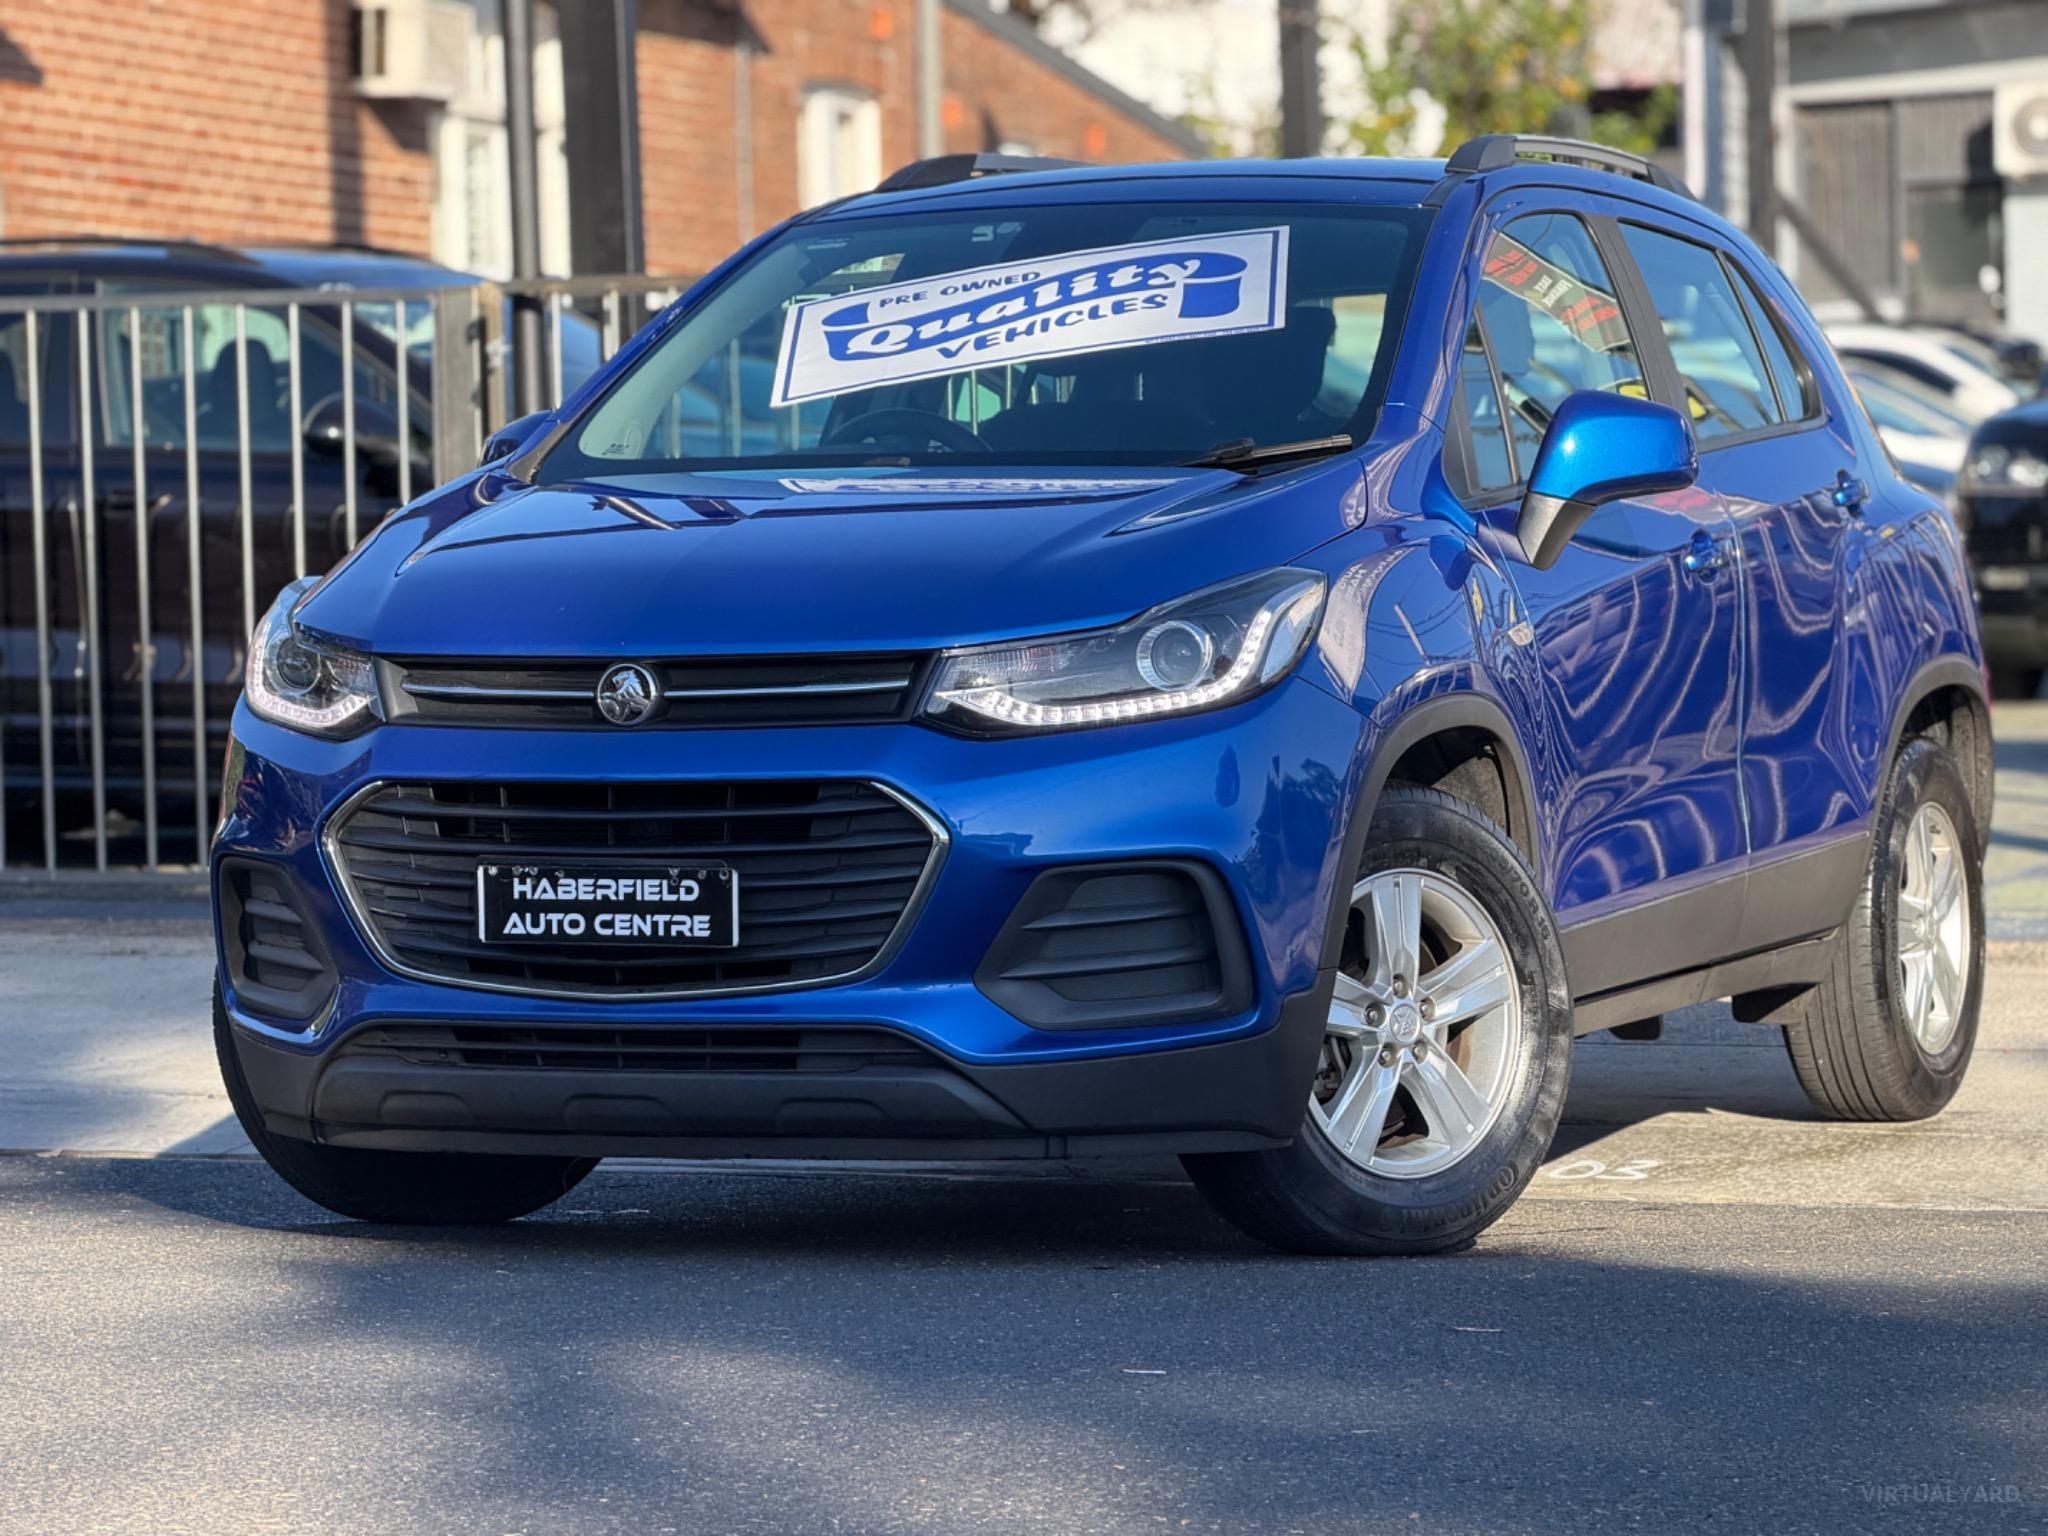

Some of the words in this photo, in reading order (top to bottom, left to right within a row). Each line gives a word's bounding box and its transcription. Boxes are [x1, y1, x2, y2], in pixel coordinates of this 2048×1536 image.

[846, 259, 1201, 355] Quality
[879, 291, 928, 308] PRE
[940, 271, 1041, 297] OWNED
[936, 293, 1169, 359] VEHICLES
[512, 877, 700, 902] HABERFIELD
[502, 912, 586, 936] AUTO
[593, 913, 712, 938] CENTRE
